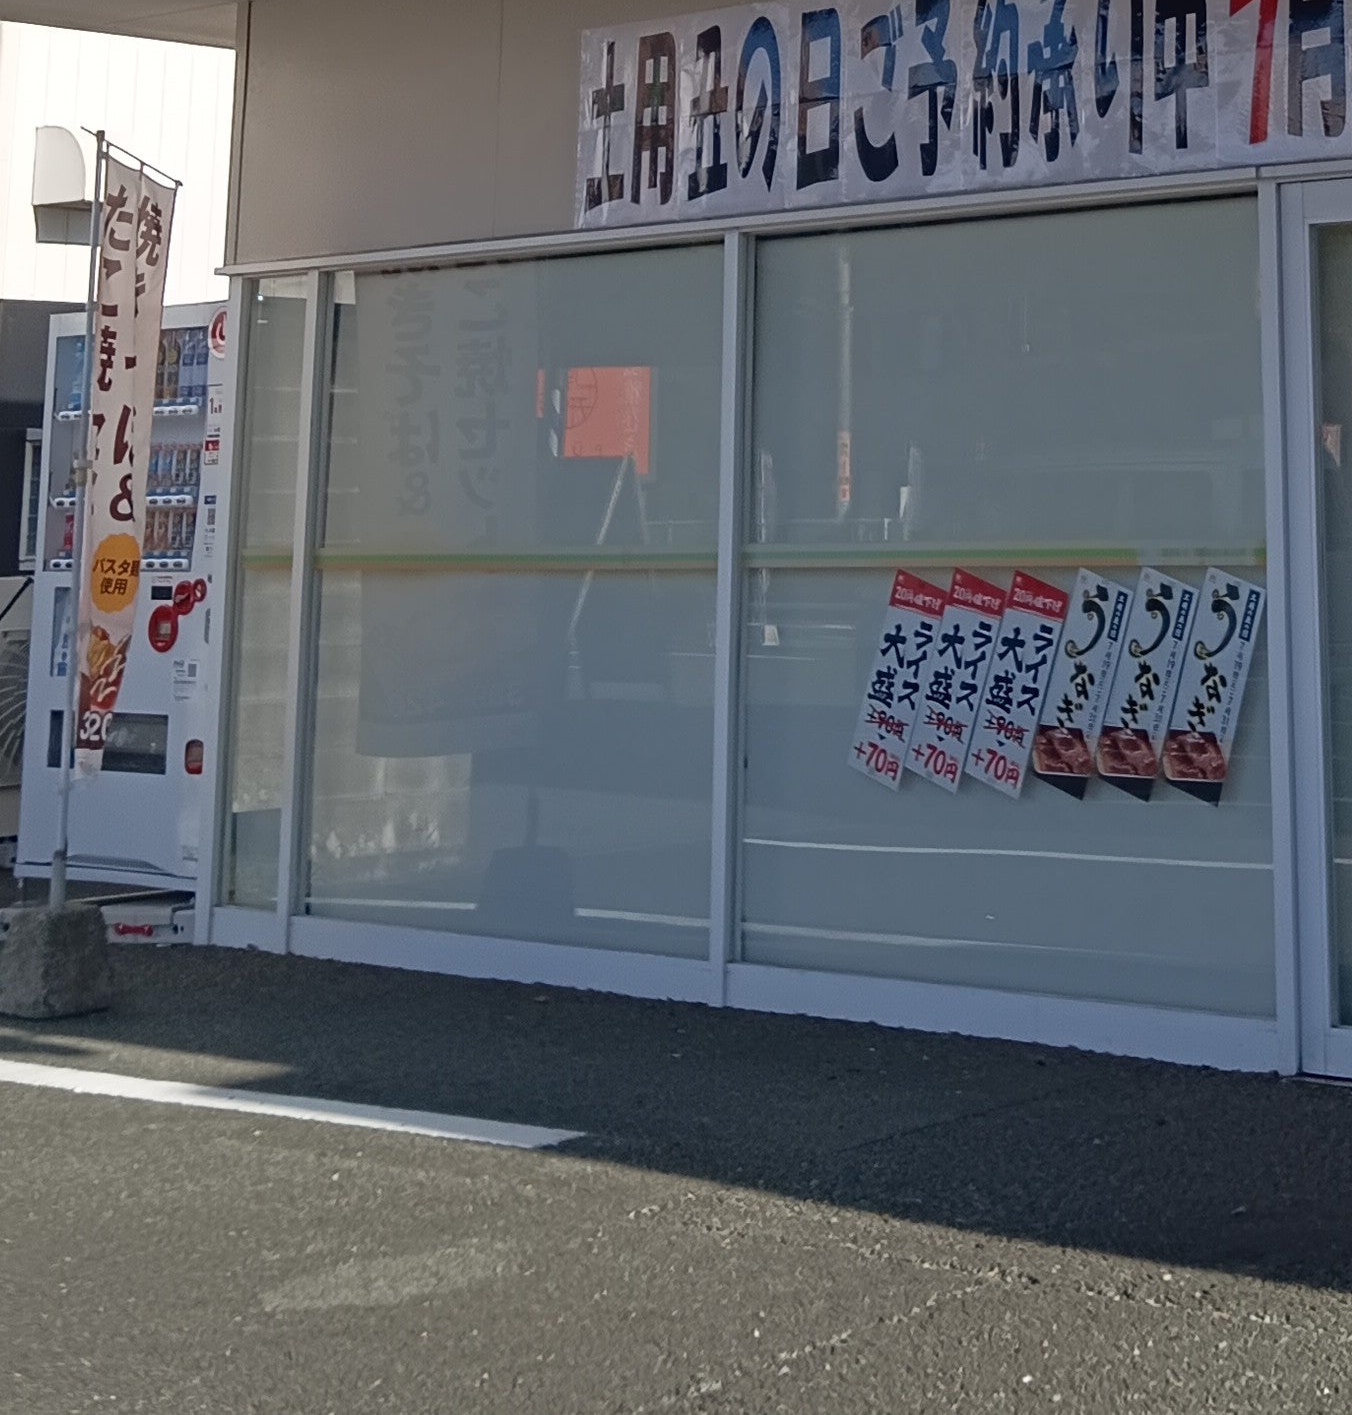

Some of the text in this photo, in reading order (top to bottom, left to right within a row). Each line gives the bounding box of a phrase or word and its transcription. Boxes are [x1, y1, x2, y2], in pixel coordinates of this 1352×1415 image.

[100, 578, 128, 595] 使用
[868, 623, 907, 709] 大盛
[898, 621, 934, 711] ライス
[925, 623, 965, 710] 大盛
[956, 621, 992, 712] ライス
[985, 626, 1026, 714] 大盛
[1017, 624, 1054, 716] ライス
[854, 740, 899, 781] +70円
[912, 743, 959, 784] +70円
[971, 748, 1020, 788] +70円
